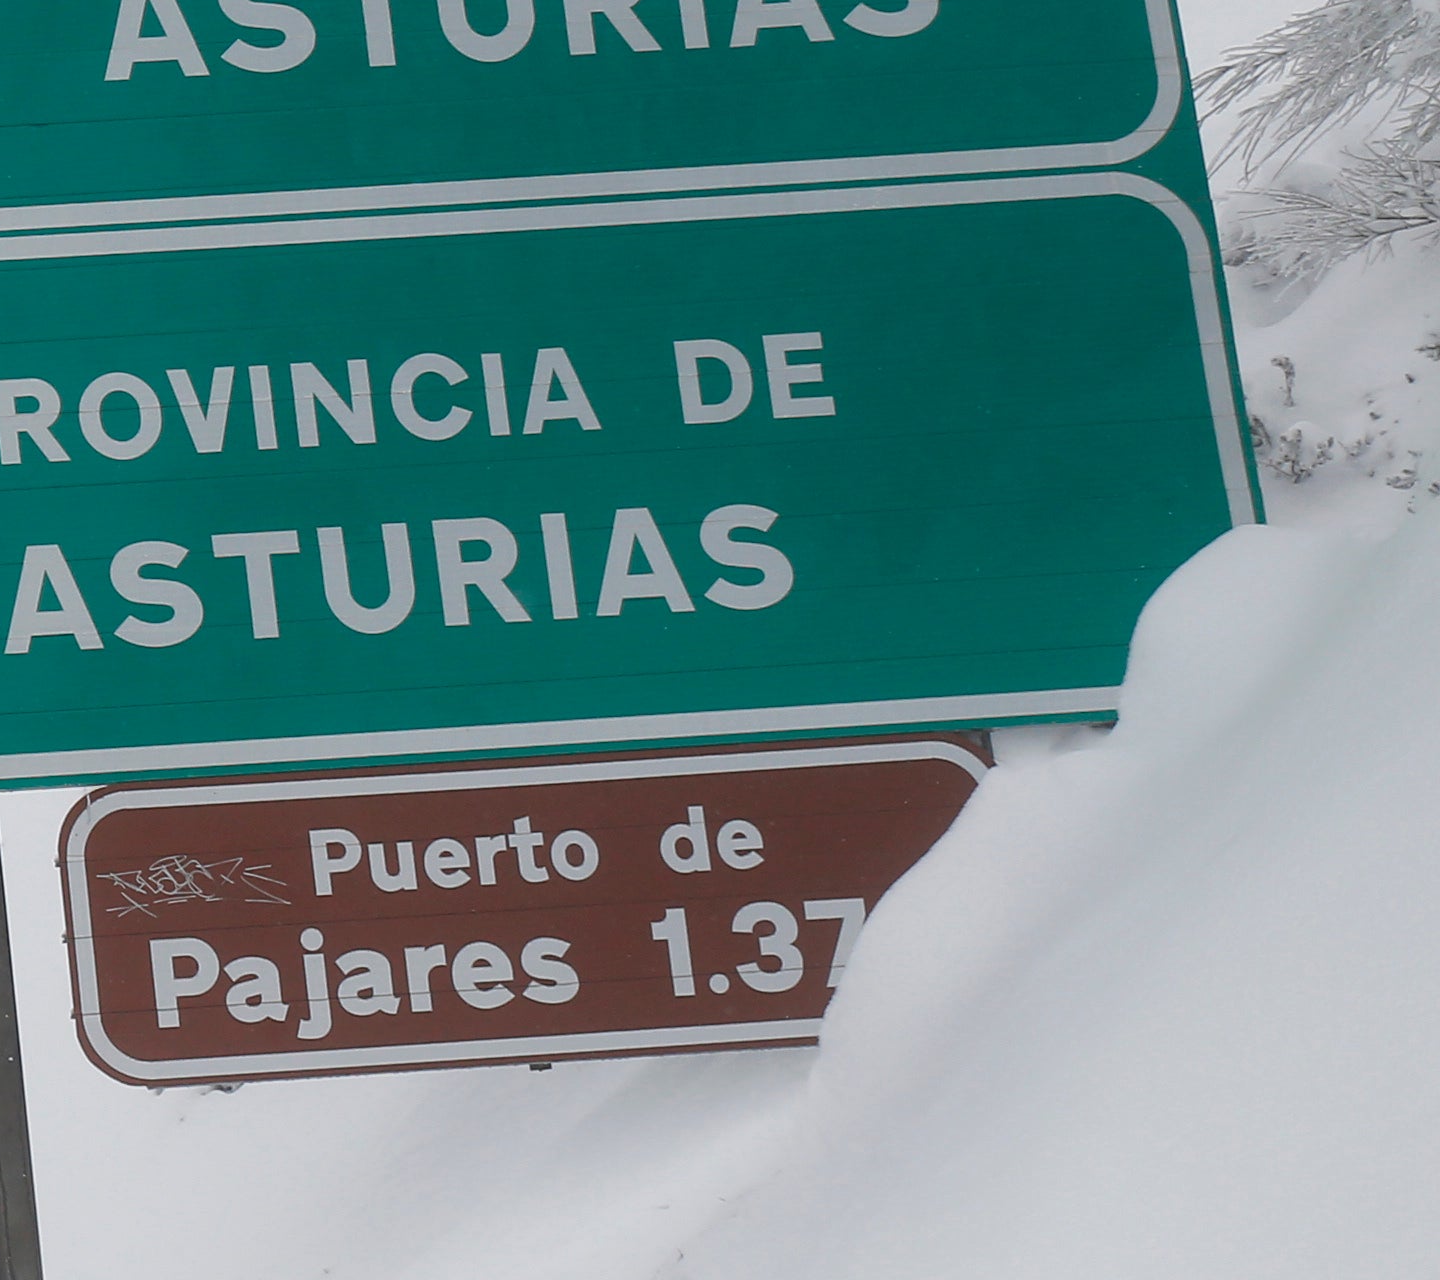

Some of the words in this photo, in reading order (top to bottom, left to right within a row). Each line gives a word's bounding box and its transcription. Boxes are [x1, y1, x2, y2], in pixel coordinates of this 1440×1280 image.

[673, 331, 836, 425] DE
[4, 504, 794, 655] ASTURIAS
[308, 816, 599, 896] Puerto
[660, 805, 764, 874] de
[149, 927, 580, 1040] Pajares
